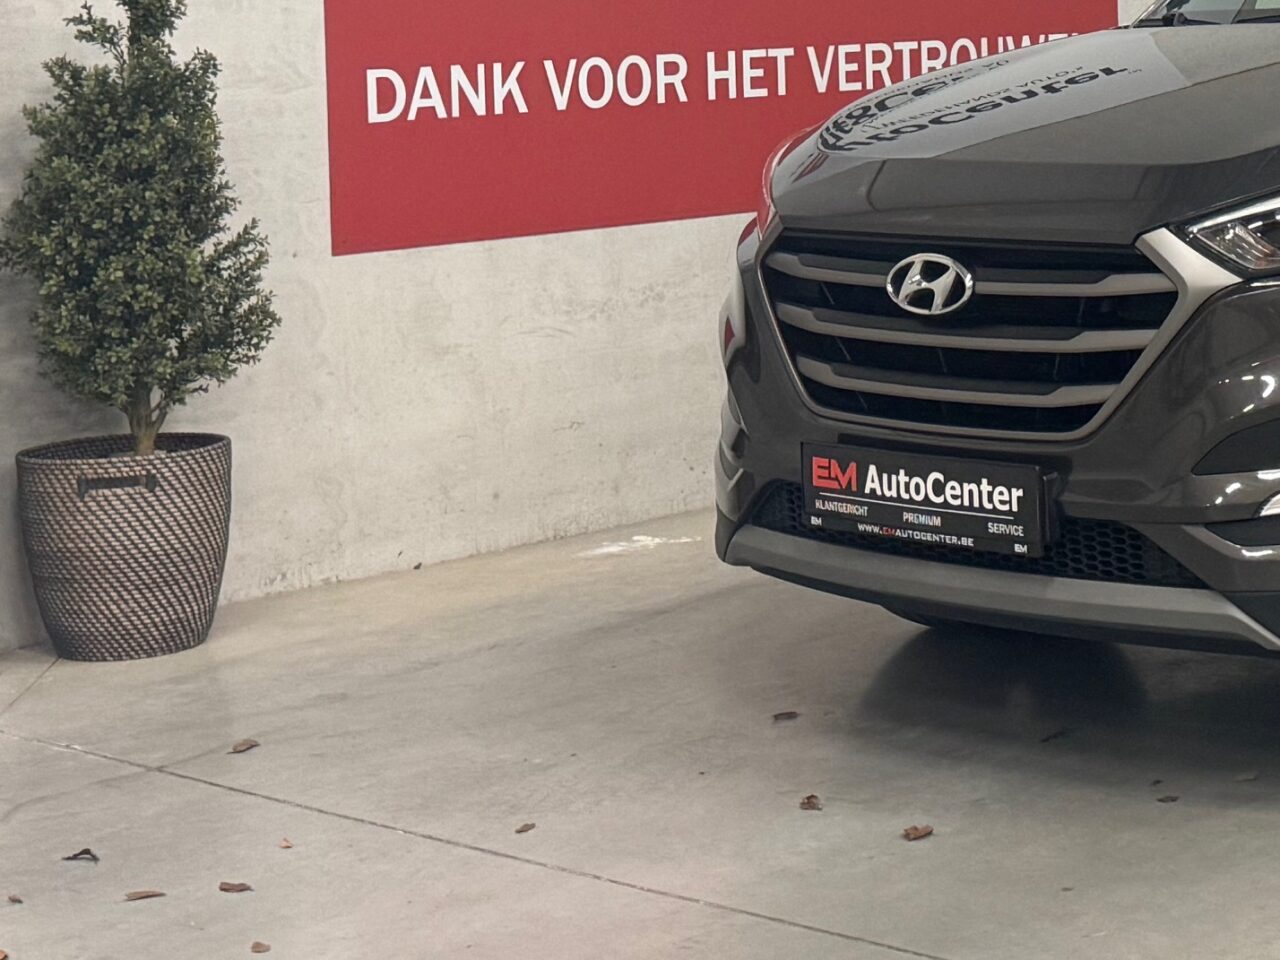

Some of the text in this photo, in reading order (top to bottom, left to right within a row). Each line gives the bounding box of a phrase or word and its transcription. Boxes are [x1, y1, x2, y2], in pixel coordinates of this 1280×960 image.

[367, 62, 529, 124] DANK
[543, 54, 688, 111] VOOR
[706, 48, 795, 101] HET
[812, 456, 1024, 512] EM AutoCenter
[903, 511, 941, 527] PREMIUM
[987, 522, 1024, 537] SERVICE
